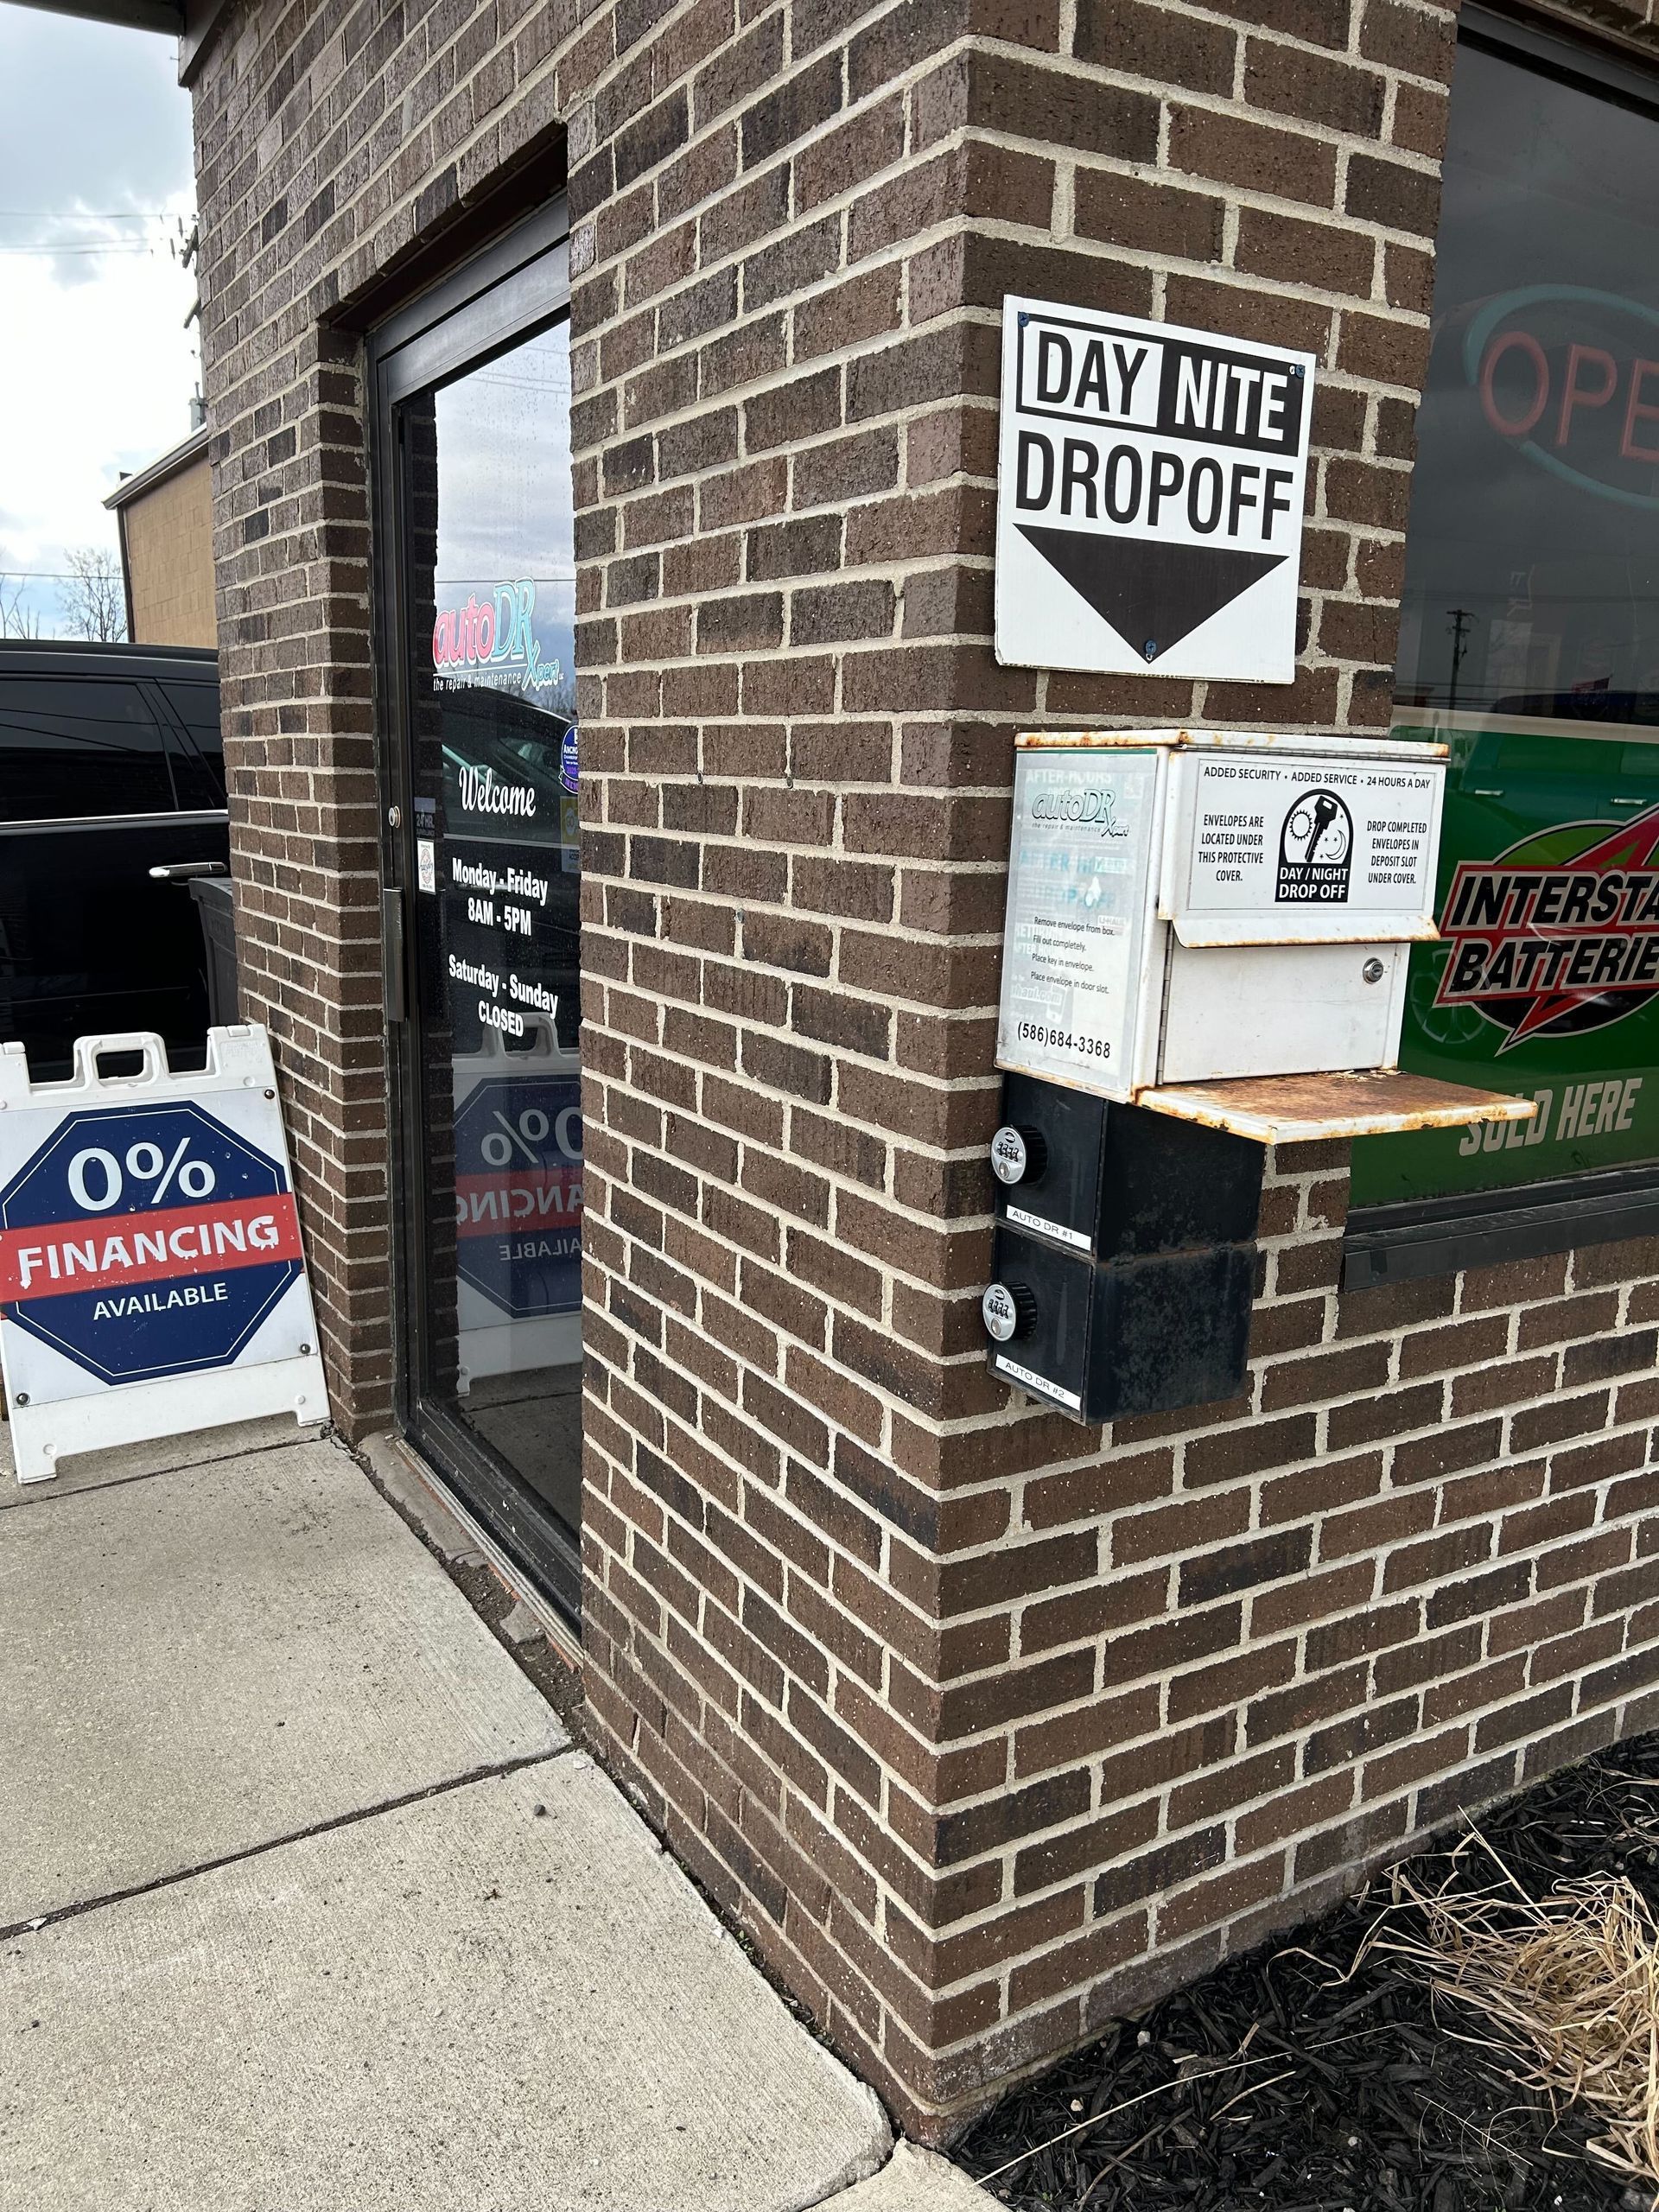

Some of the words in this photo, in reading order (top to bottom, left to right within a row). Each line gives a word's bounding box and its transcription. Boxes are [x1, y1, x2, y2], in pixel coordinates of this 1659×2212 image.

[1036, 330, 1148, 416] DAY
[1174, 356, 1287, 442] NITE
[1015, 429, 1294, 540] DROPOFF
[433, 677, 443, 691] the
[446, 676, 467, 692] repair
[467, 676, 473, 689] &
[474, 672, 522, 687] maintenance
[1204, 766, 1236, 778] ADDED
[1238, 768, 1281, 780] SECURITY
[1291, 772, 1322, 784] ADDED
[1324, 773, 1357, 785] SERVICE
[1367, 776, 1377, 786] 24
[1378, 777, 1406, 788] HOURS
[1407, 779, 1414, 788] A
[1414, 779, 1431, 789] DAY
[459, 766, 537, 817] Welcome
[1042, 823, 1058, 832] repair
[1065, 824, 1101, 833] maintenance
[1204, 814, 1247, 827] ENVELOPES
[1249, 816, 1264, 828] ARE
[1367, 820, 1386, 832] DROP
[1387, 821, 1427, 834] COMPLETED
[1201, 833, 1236, 845] LOCATED
[1236, 834, 1263, 846] UNDER
[1371, 838, 1410, 850] ENVELOPES
[1411, 839, 1420, 850] IN
[1198, 851, 1216, 863] THIS
[1217, 851, 1263, 864] PROTECTIVE
[1370, 855, 1400, 868] DEPOSIT
[1400, 856, 1417, 868] SLOT
[452, 857, 497, 894] Monday
[507, 868, 549, 906] Friday
[1216, 869, 1243, 882] COVER.
[1279, 867, 1304, 880] DAY
[1312, 867, 1348, 880] NIGHT
[1368, 872, 1391, 884] UNDER
[1393, 872, 1417, 884] COVER.
[1279, 884, 1318, 899] DROP
[1319, 884, 1345, 899] OFF
[467, 898, 493, 926] 8AM
[504, 906, 531, 936] 5PM
[1034, 916, 1057, 928] Remove
[1058, 921, 1084, 932] envelope
[1086, 923, 1101, 933] from
[1102, 926, 1116, 936] box.
[1033, 934, 1041, 944] Fill
[1042, 937, 1052, 946] out
[1052, 938, 1087, 953] completely.
[1032, 953, 1047, 963] Place
[1047, 955, 1057, 966] key
[1065, 960, 1095, 972] envelope.
[1448, 936, 1659, 993] BATTERIE
[448, 954, 499, 998] Saturday
[509, 974, 559, 1020] Sunday
[1030, 971, 1046, 982] Place
[1046, 975, 1072, 987] envelope
[1073, 979, 1080, 988] in
[1081, 980, 1096, 990] door
[1096, 983, 1109, 994] slot.
[478, 1001, 524, 1038] CLOSED
[1018, 1021, 1110, 1058] (586)684-3368
[1555, 1077, 1643, 1141] HERE
[67, 1136, 216, 1211] 0%
[1013, 1211, 1040, 1227] AUTO
[1044, 1223, 1058, 1234] DR
[1062, 1230, 1073, 1240] #1
[17, 1215, 279, 1289] FINANCING
[93, 1283, 228, 1321] AVAILABLE
[1006, 1362, 1033, 1381] AUTO
[1035, 1377, 1050, 1390] DR
[1053, 1388, 1065, 1399] #2
